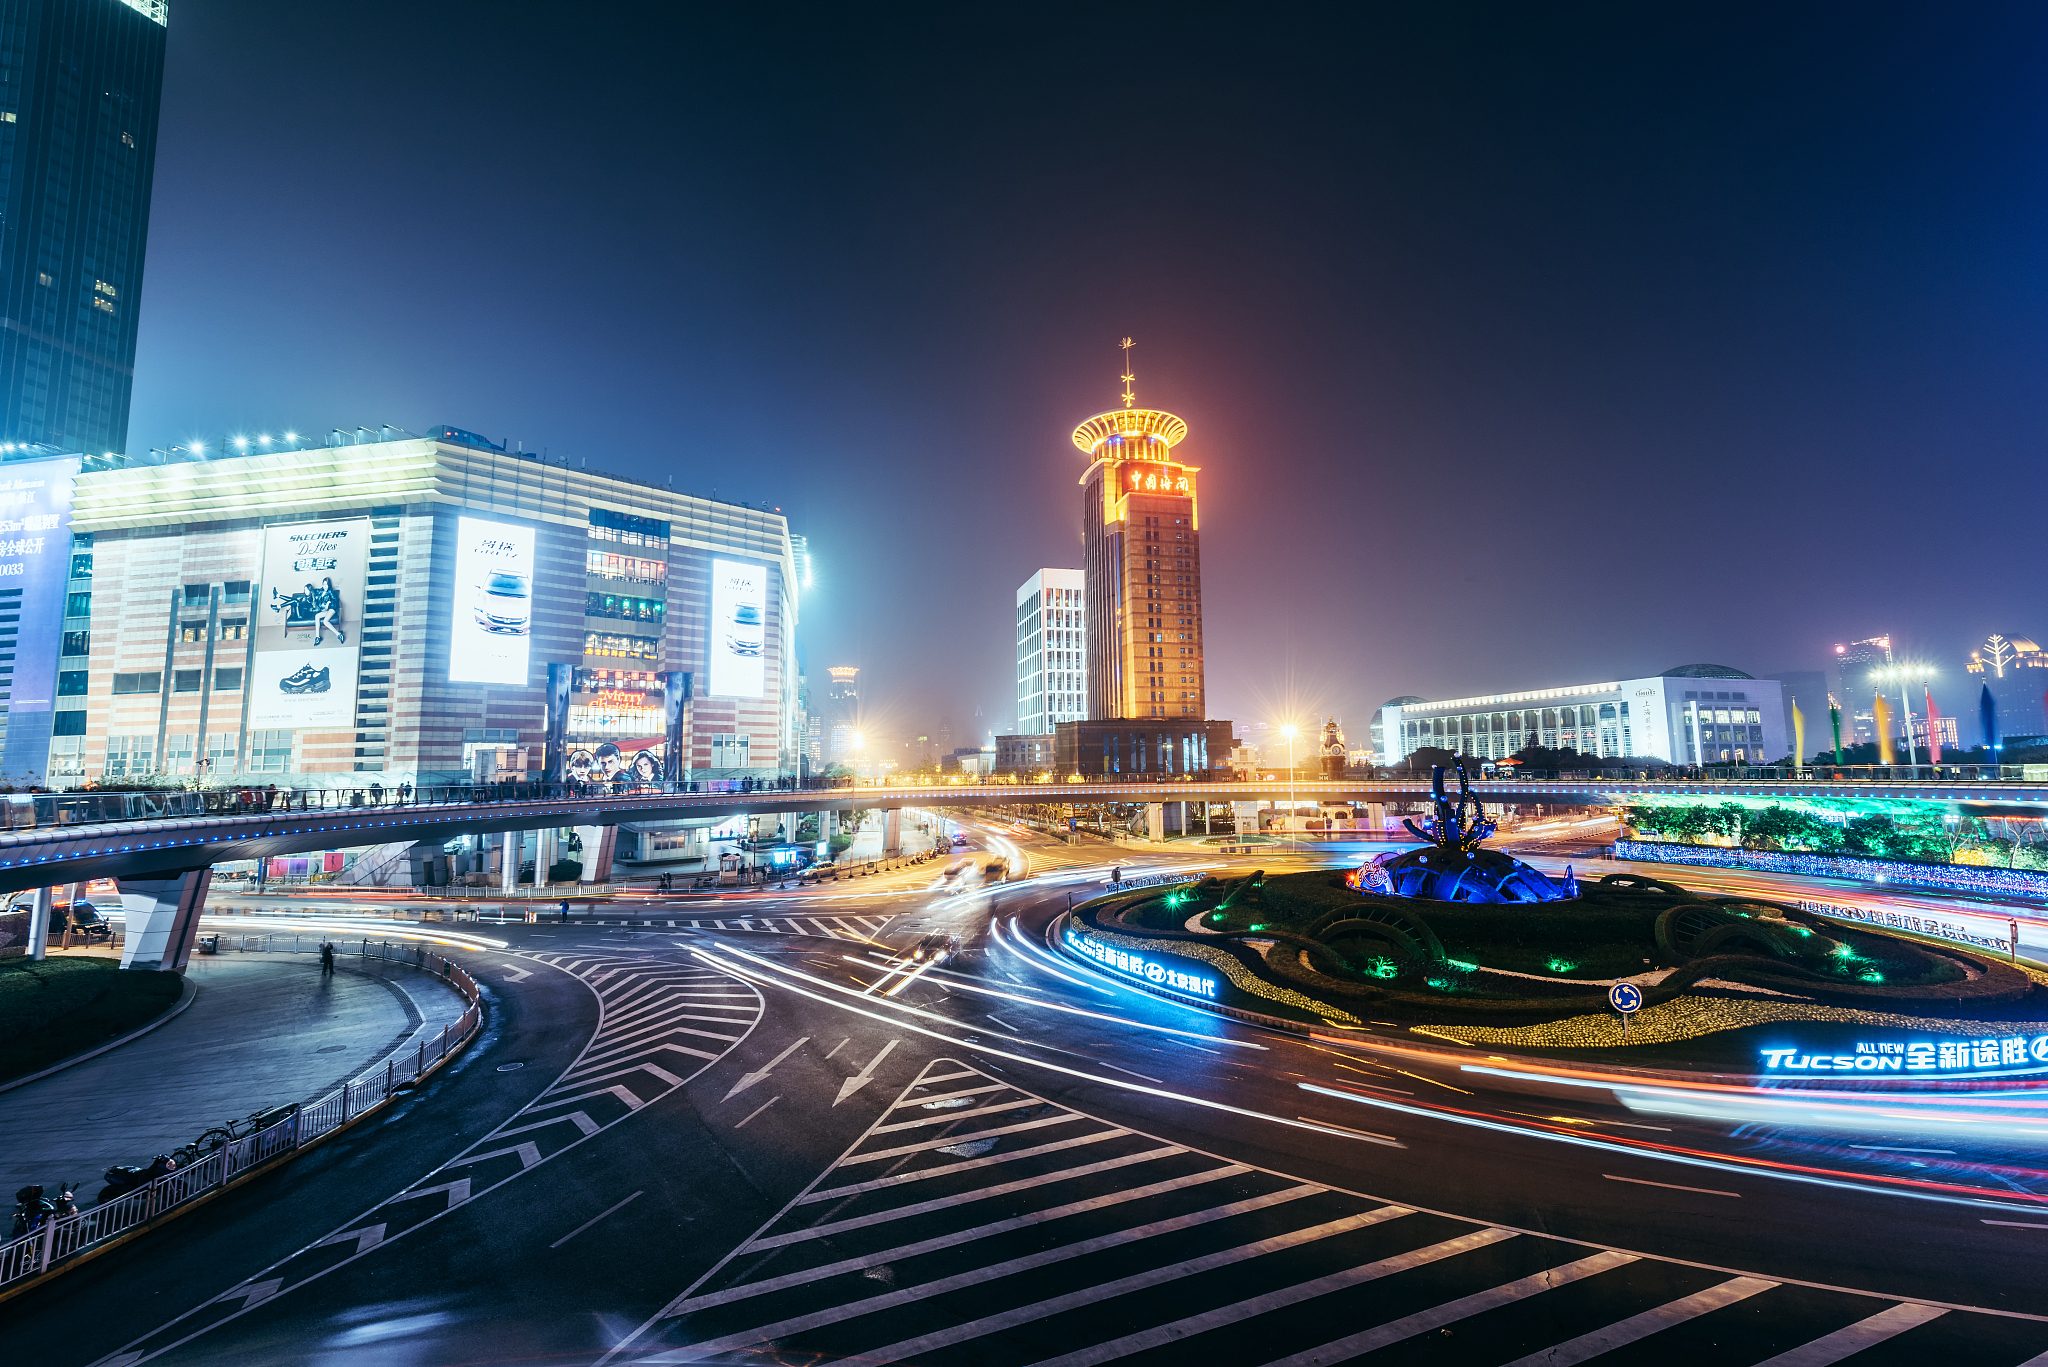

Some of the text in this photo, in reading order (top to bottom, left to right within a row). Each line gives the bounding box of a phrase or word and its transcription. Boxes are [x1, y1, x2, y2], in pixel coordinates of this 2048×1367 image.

[289, 530, 349, 542] SKECHERS
[603, 689, 646, 705] Merry
[588, 697, 656, 714] Christmas
[1096, 943, 1144, 975] 全新途胜
[1167, 970, 1215, 996] 北京现代
[1858, 1042, 1904, 1054] ALL NEW
[1905, 1037, 2029, 1069] 全新途胜
